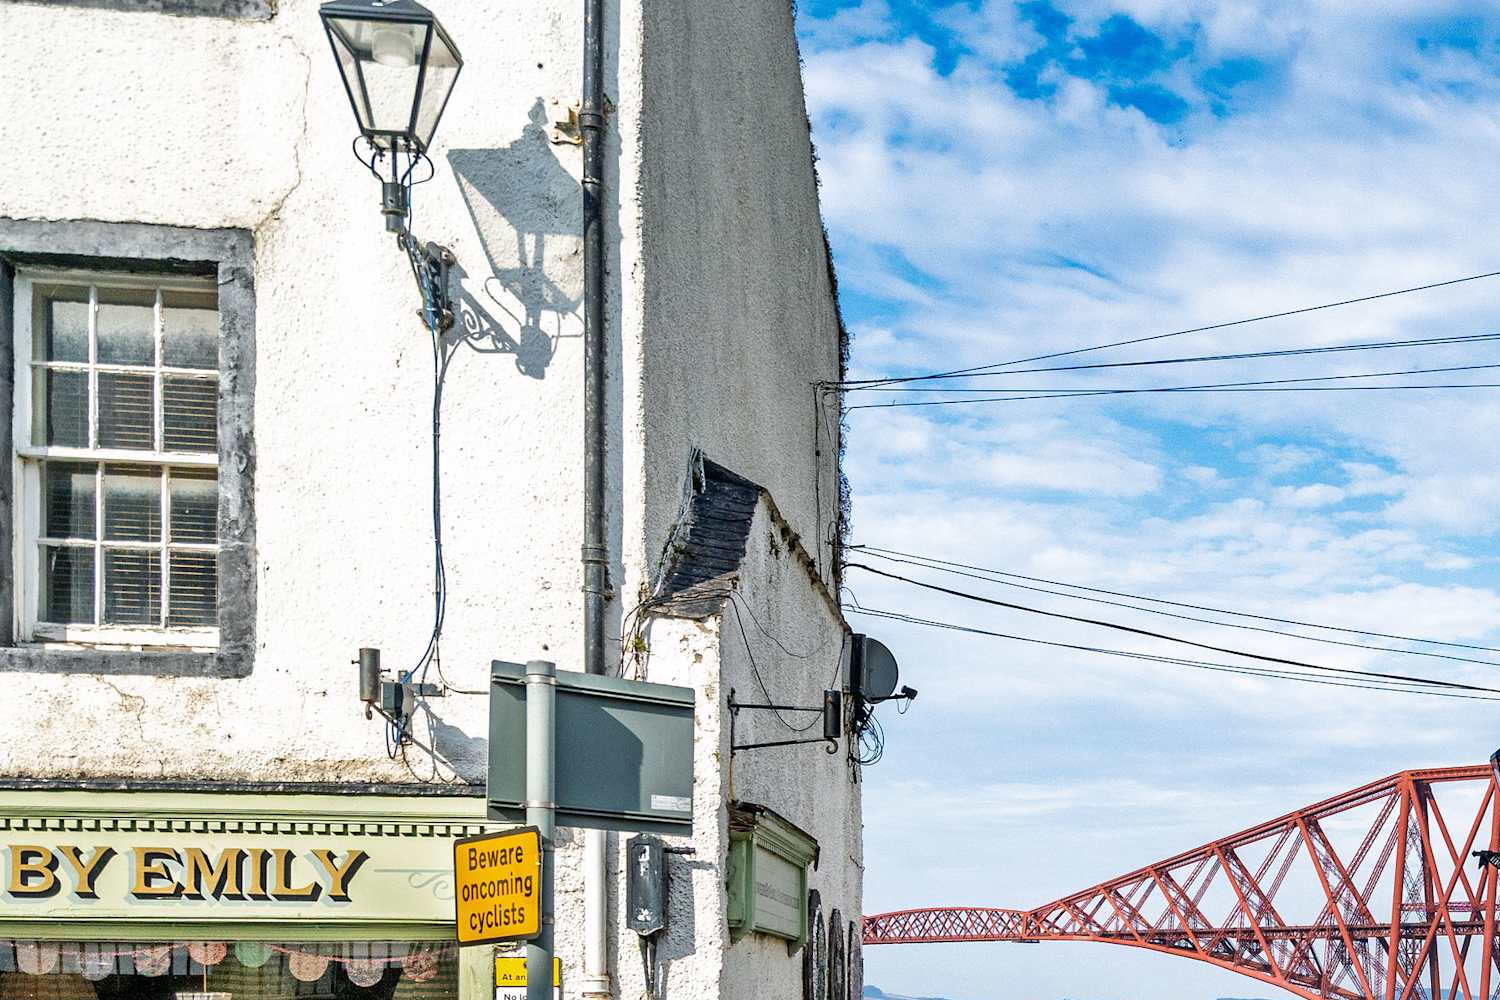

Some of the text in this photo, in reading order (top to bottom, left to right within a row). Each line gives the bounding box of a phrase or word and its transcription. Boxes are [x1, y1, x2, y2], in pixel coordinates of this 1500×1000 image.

[7, 844, 371, 902] BY EMILY
[468, 845, 524, 871] Beware
[462, 872, 533, 902] oncoming
[469, 902, 525, 934] cyclists
[502, 973, 512, 981] At
